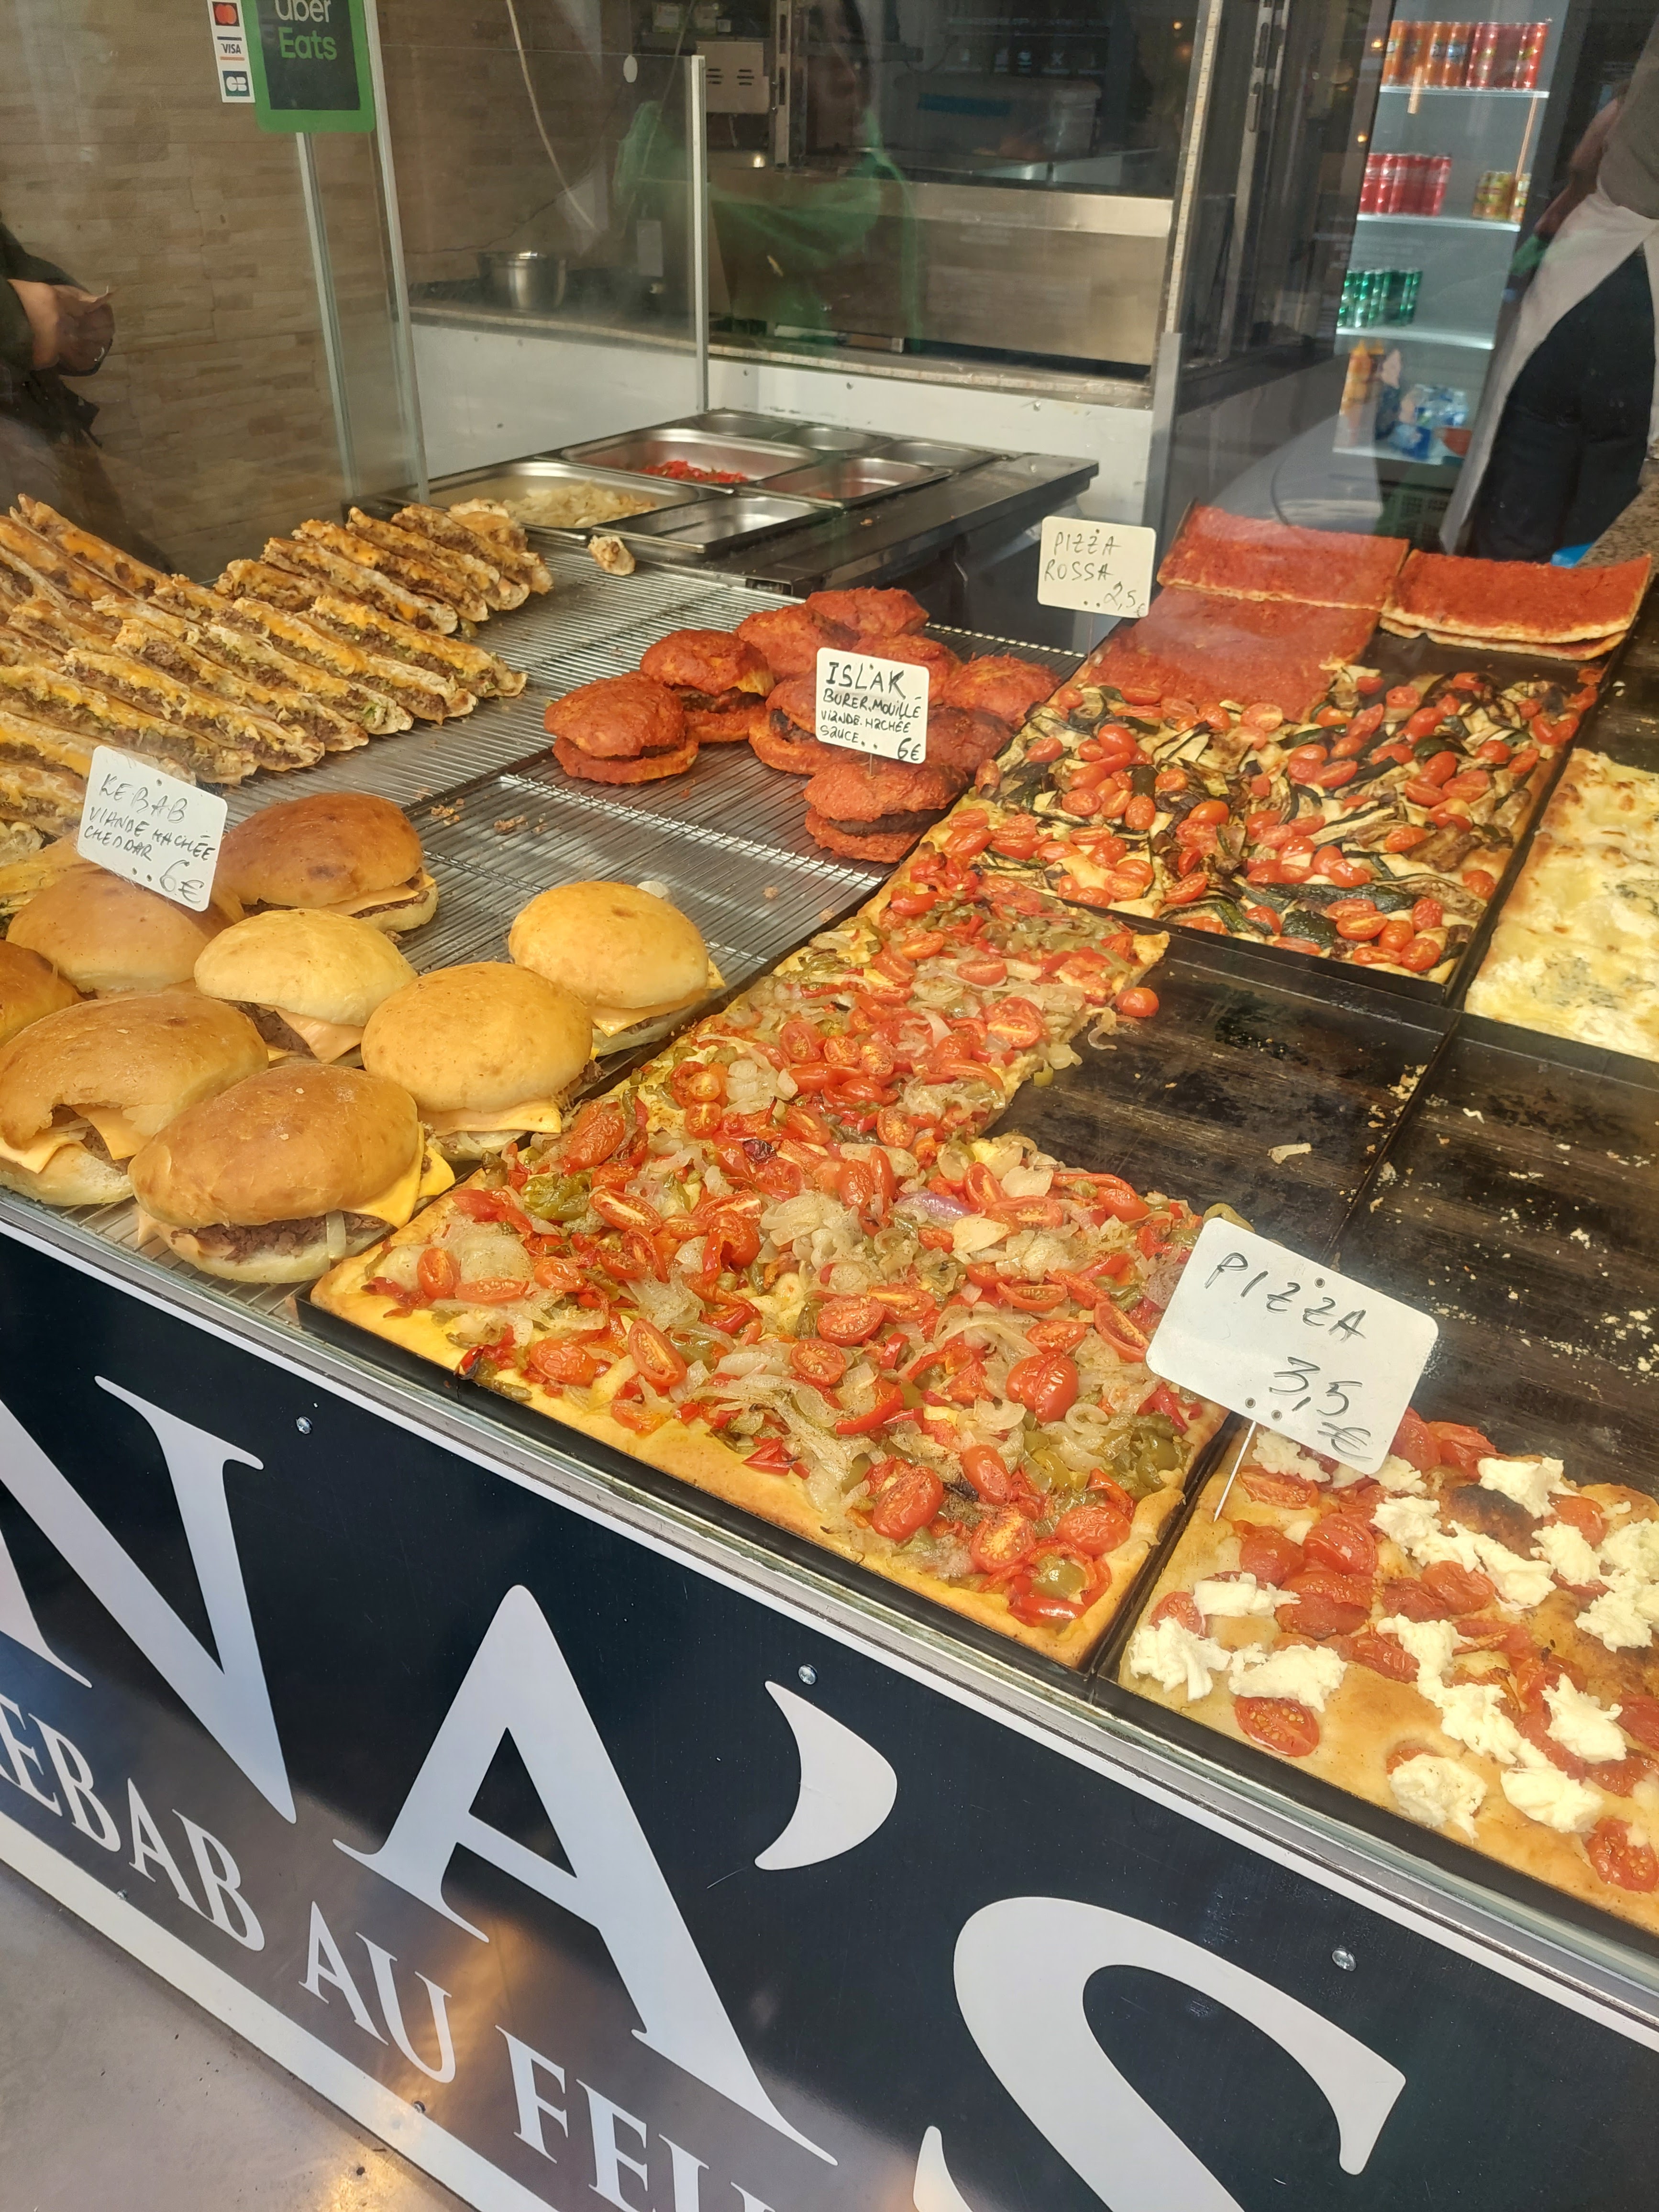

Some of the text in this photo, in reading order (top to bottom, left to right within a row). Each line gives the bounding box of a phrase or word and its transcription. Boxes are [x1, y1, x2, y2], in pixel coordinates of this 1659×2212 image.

[221, 43, 242, 55] VISA
[277, 26, 337, 61] Eats
[1053, 531, 1122, 556] PIZZA
[1044, 558, 1114, 582] ROSSA
[826, 662, 906, 700] ISLAK
[99, 773, 188, 823] KEBAB
[89, 806, 150, 837] VIANDE
[84, 825, 152, 862] CHEDDAR
[159, 860, 205, 903] 6€
[1204, 1252, 1367, 1341] PIZZA
[0, 1693, 265, 1951] EBAB
[299, 1901, 456, 2083] AU
